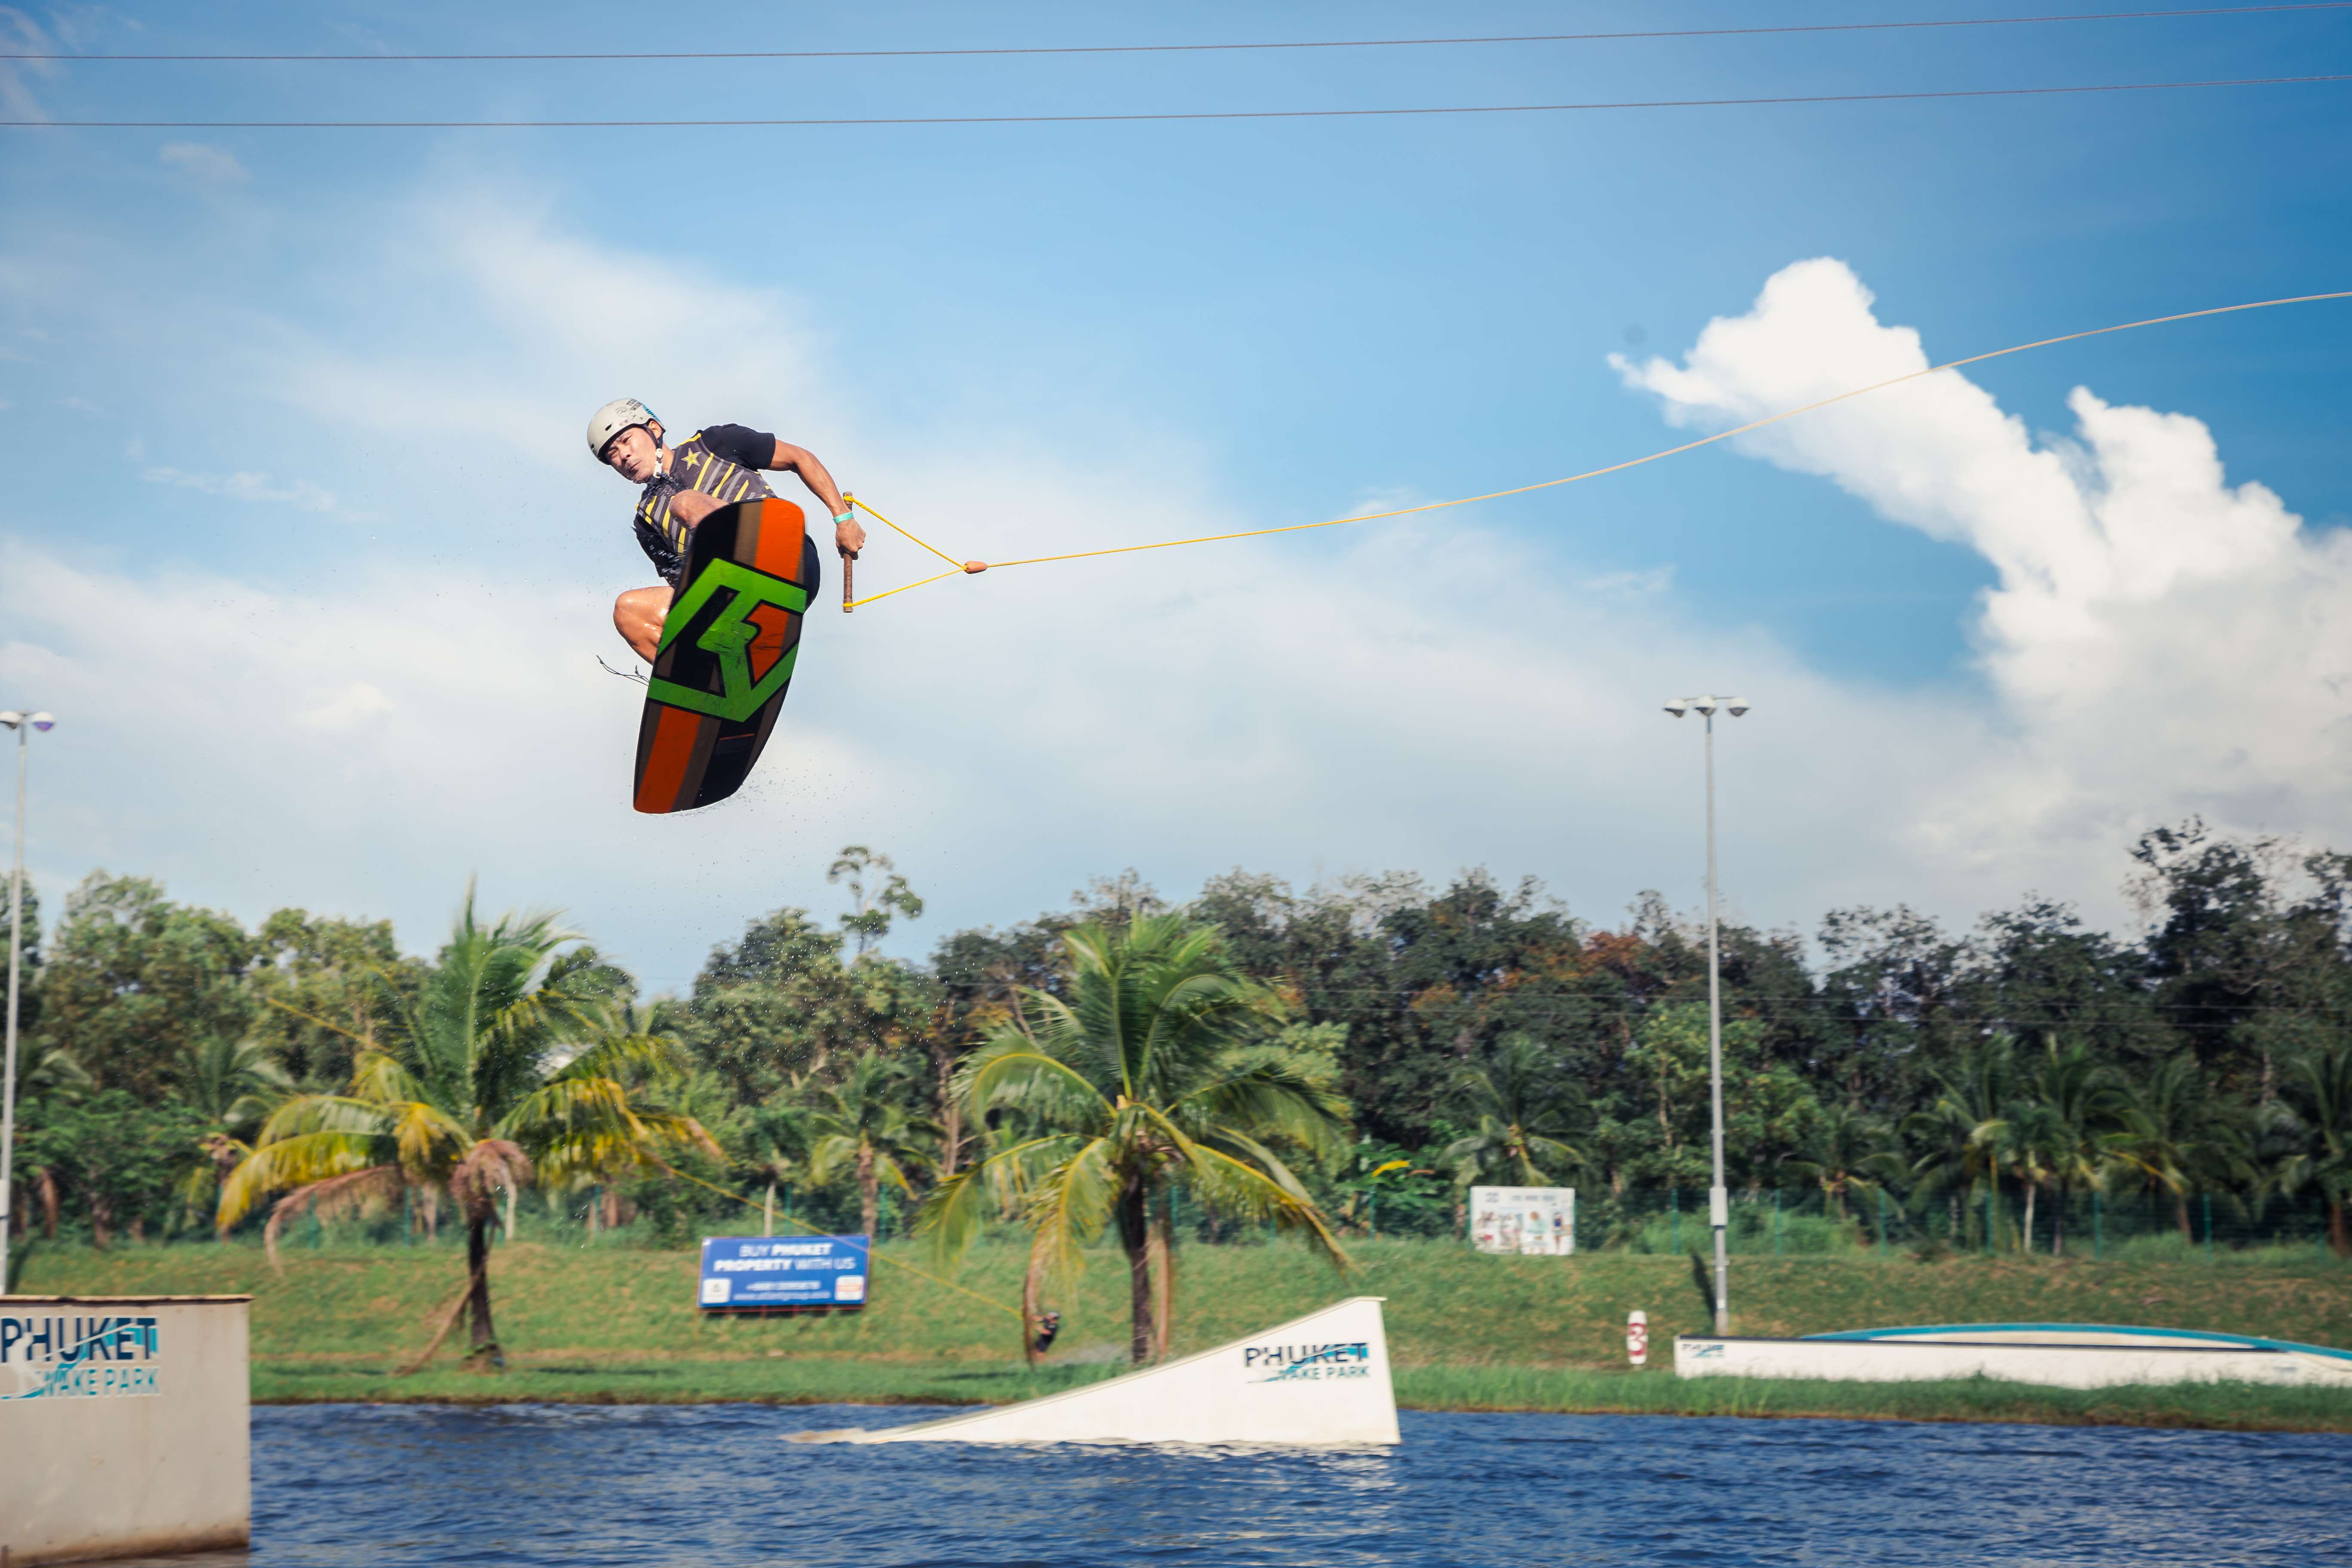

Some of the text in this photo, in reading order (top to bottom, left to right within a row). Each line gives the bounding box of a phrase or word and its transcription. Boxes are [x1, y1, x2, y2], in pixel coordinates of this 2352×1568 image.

[0, 1317, 157, 1363] PHUKET
[1245, 1342, 1367, 1367] PHUKET
[104, 1368, 160, 1396] PARK
[1326, 1365, 1370, 1378] PARK
